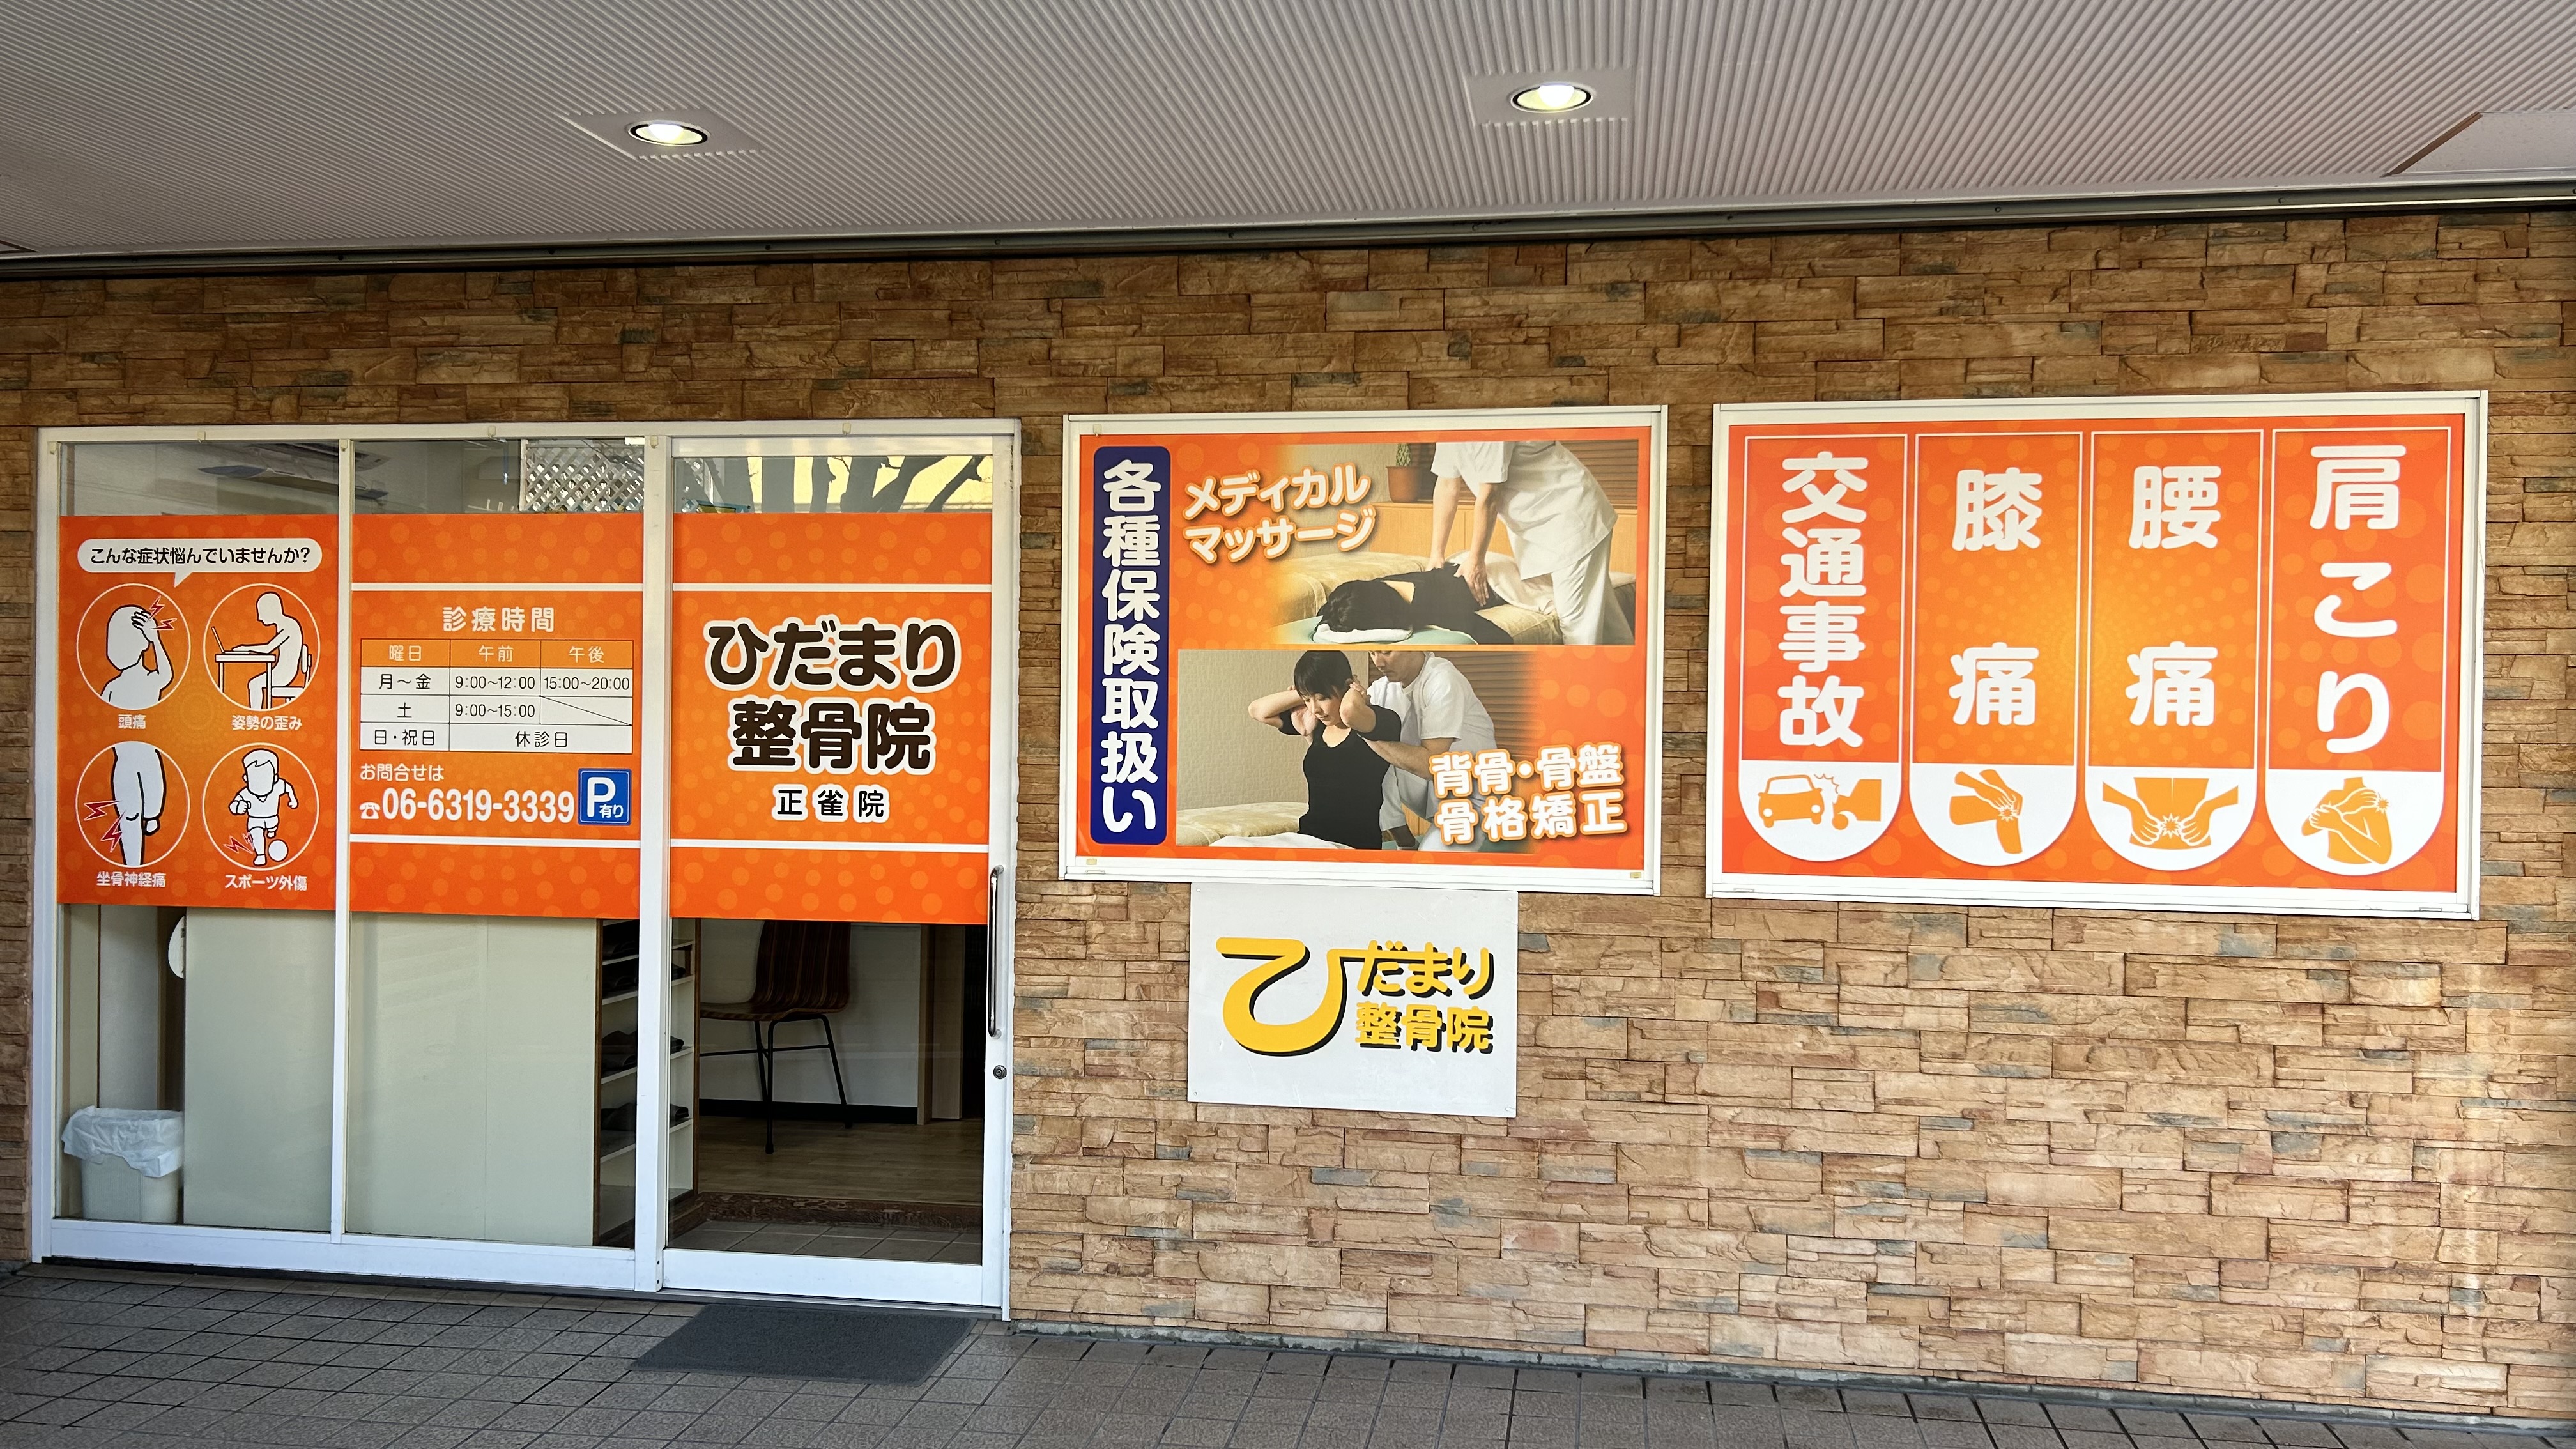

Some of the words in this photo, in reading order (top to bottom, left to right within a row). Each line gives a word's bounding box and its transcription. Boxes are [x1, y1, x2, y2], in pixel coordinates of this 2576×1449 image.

[1184, 464, 1370, 520] メディカル
[1184, 507, 1376, 563] マッサージ
[91, 546, 310, 565] こんな症状悩んでいませんか?
[1778, 450, 1869, 749] 交通事故
[1948, 466, 2043, 727] 膝痛
[2126, 465, 2221, 727] 腰痛
[2310, 445, 2407, 755] 肩こり
[443, 606, 555, 632] 診療時間
[389, 645, 422, 662] 曜日
[479, 645, 514, 662] 午前
[569, 646, 604, 663] 午後
[709, 620, 956, 687] ひだまり
[1101, 460, 1162, 833] 各種保険取扱い
[379, 673, 431, 691] 月～金
[455, 676, 535, 690] 9:00～12:00
[544, 677, 630, 691] 15:00～20:00
[397, 703, 412, 719] 土
[455, 703, 535, 717] 9:00～15:00
[118, 714, 146, 730] 頭痛
[231, 714, 303, 731] 姿勢の歪み
[374, 730, 435, 746] 日・祝日
[515, 731, 568, 747] 休診日
[733, 701, 930, 769] 整骨院
[360, 763, 444, 781] お問合せは
[1431, 744, 1623, 797] 背骨・骨盤
[383, 788, 574, 823] 06-6319-3339
[587, 776, 615, 817] P
[776, 790, 884, 817] 正雀院
[599, 804, 624, 818] 有り
[1436, 791, 1626, 844] 骨格矯正
[96, 871, 166, 888] 坐骨神経痛
[225, 873, 307, 891] スポーツ外傷
[1216, 937, 1494, 1056] ひだまり
[1354, 1000, 1493, 1054] 整骨院
